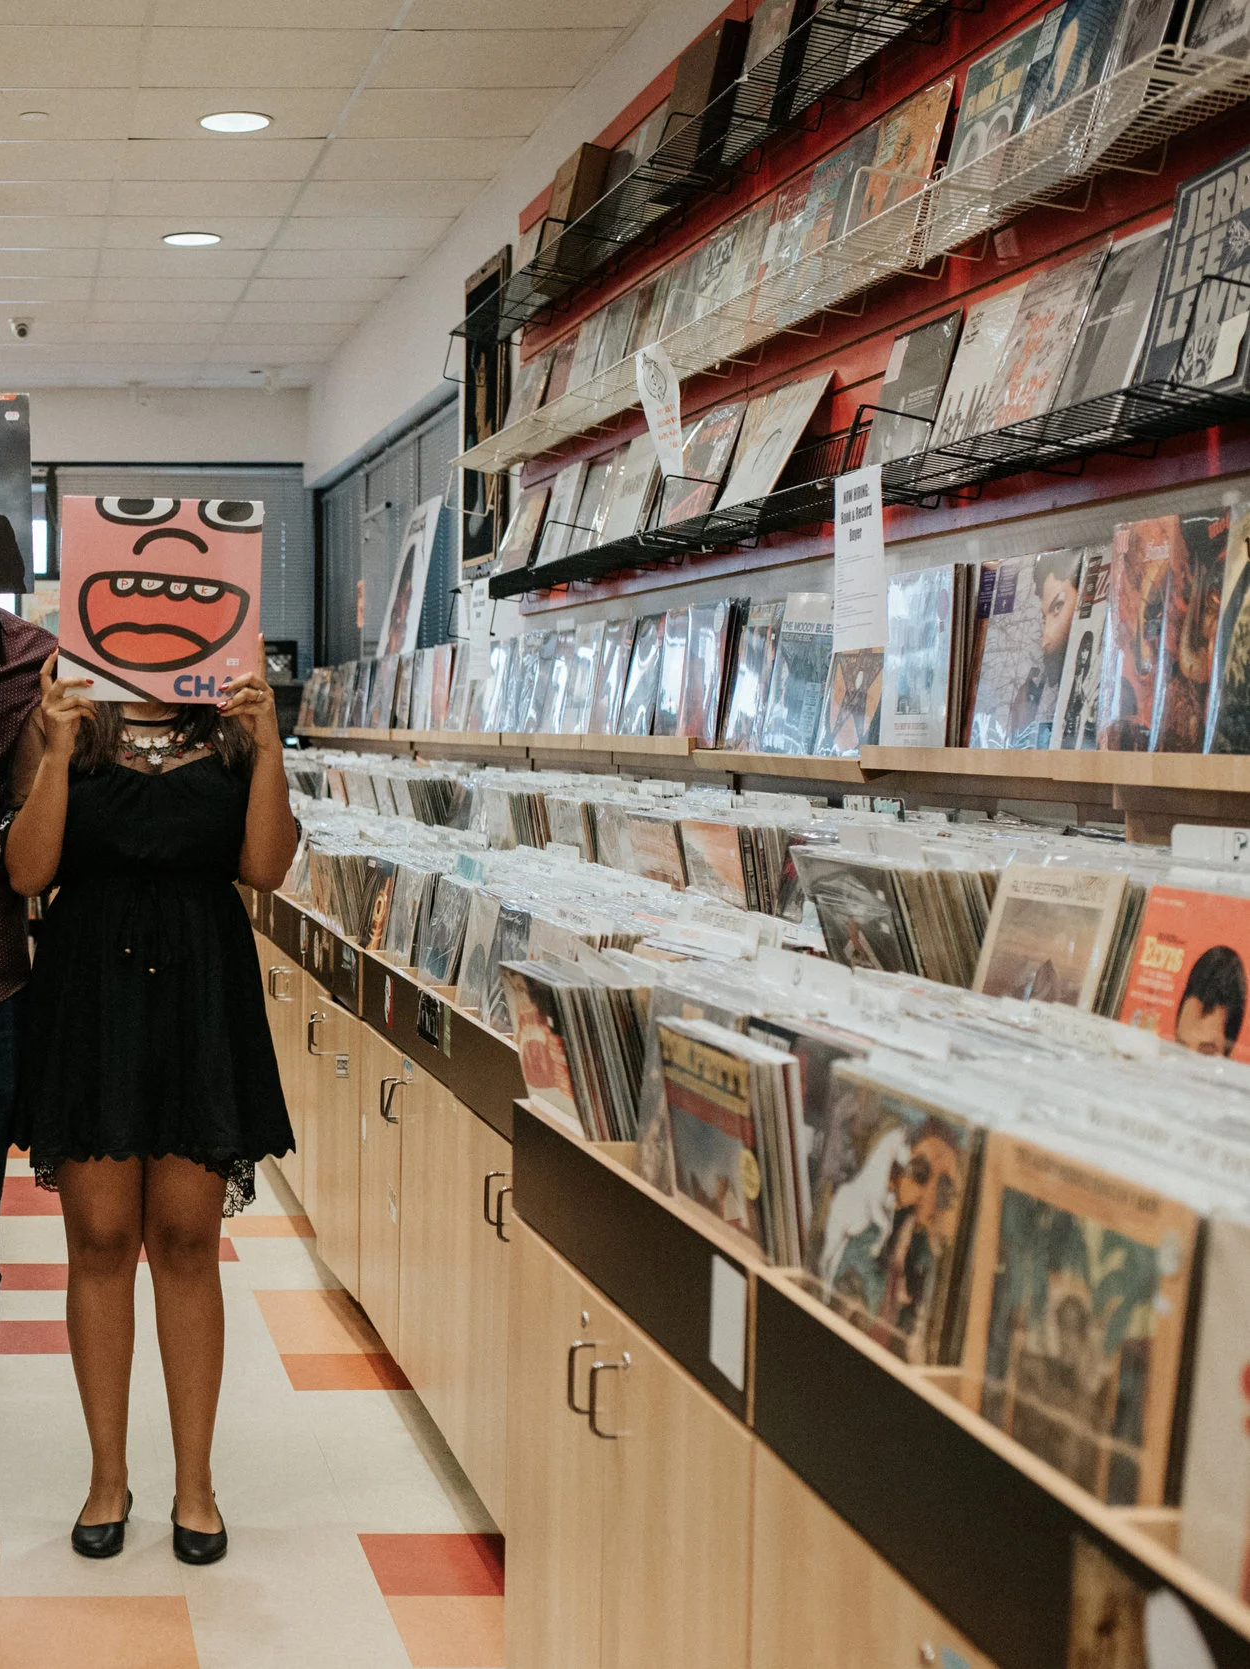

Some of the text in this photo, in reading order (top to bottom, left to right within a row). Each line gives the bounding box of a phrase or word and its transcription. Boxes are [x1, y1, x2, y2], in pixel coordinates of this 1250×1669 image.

[1168, 222, 1228, 297] LEE
[782, 621, 794, 631] THE
[793, 621, 815, 633] MOODY
